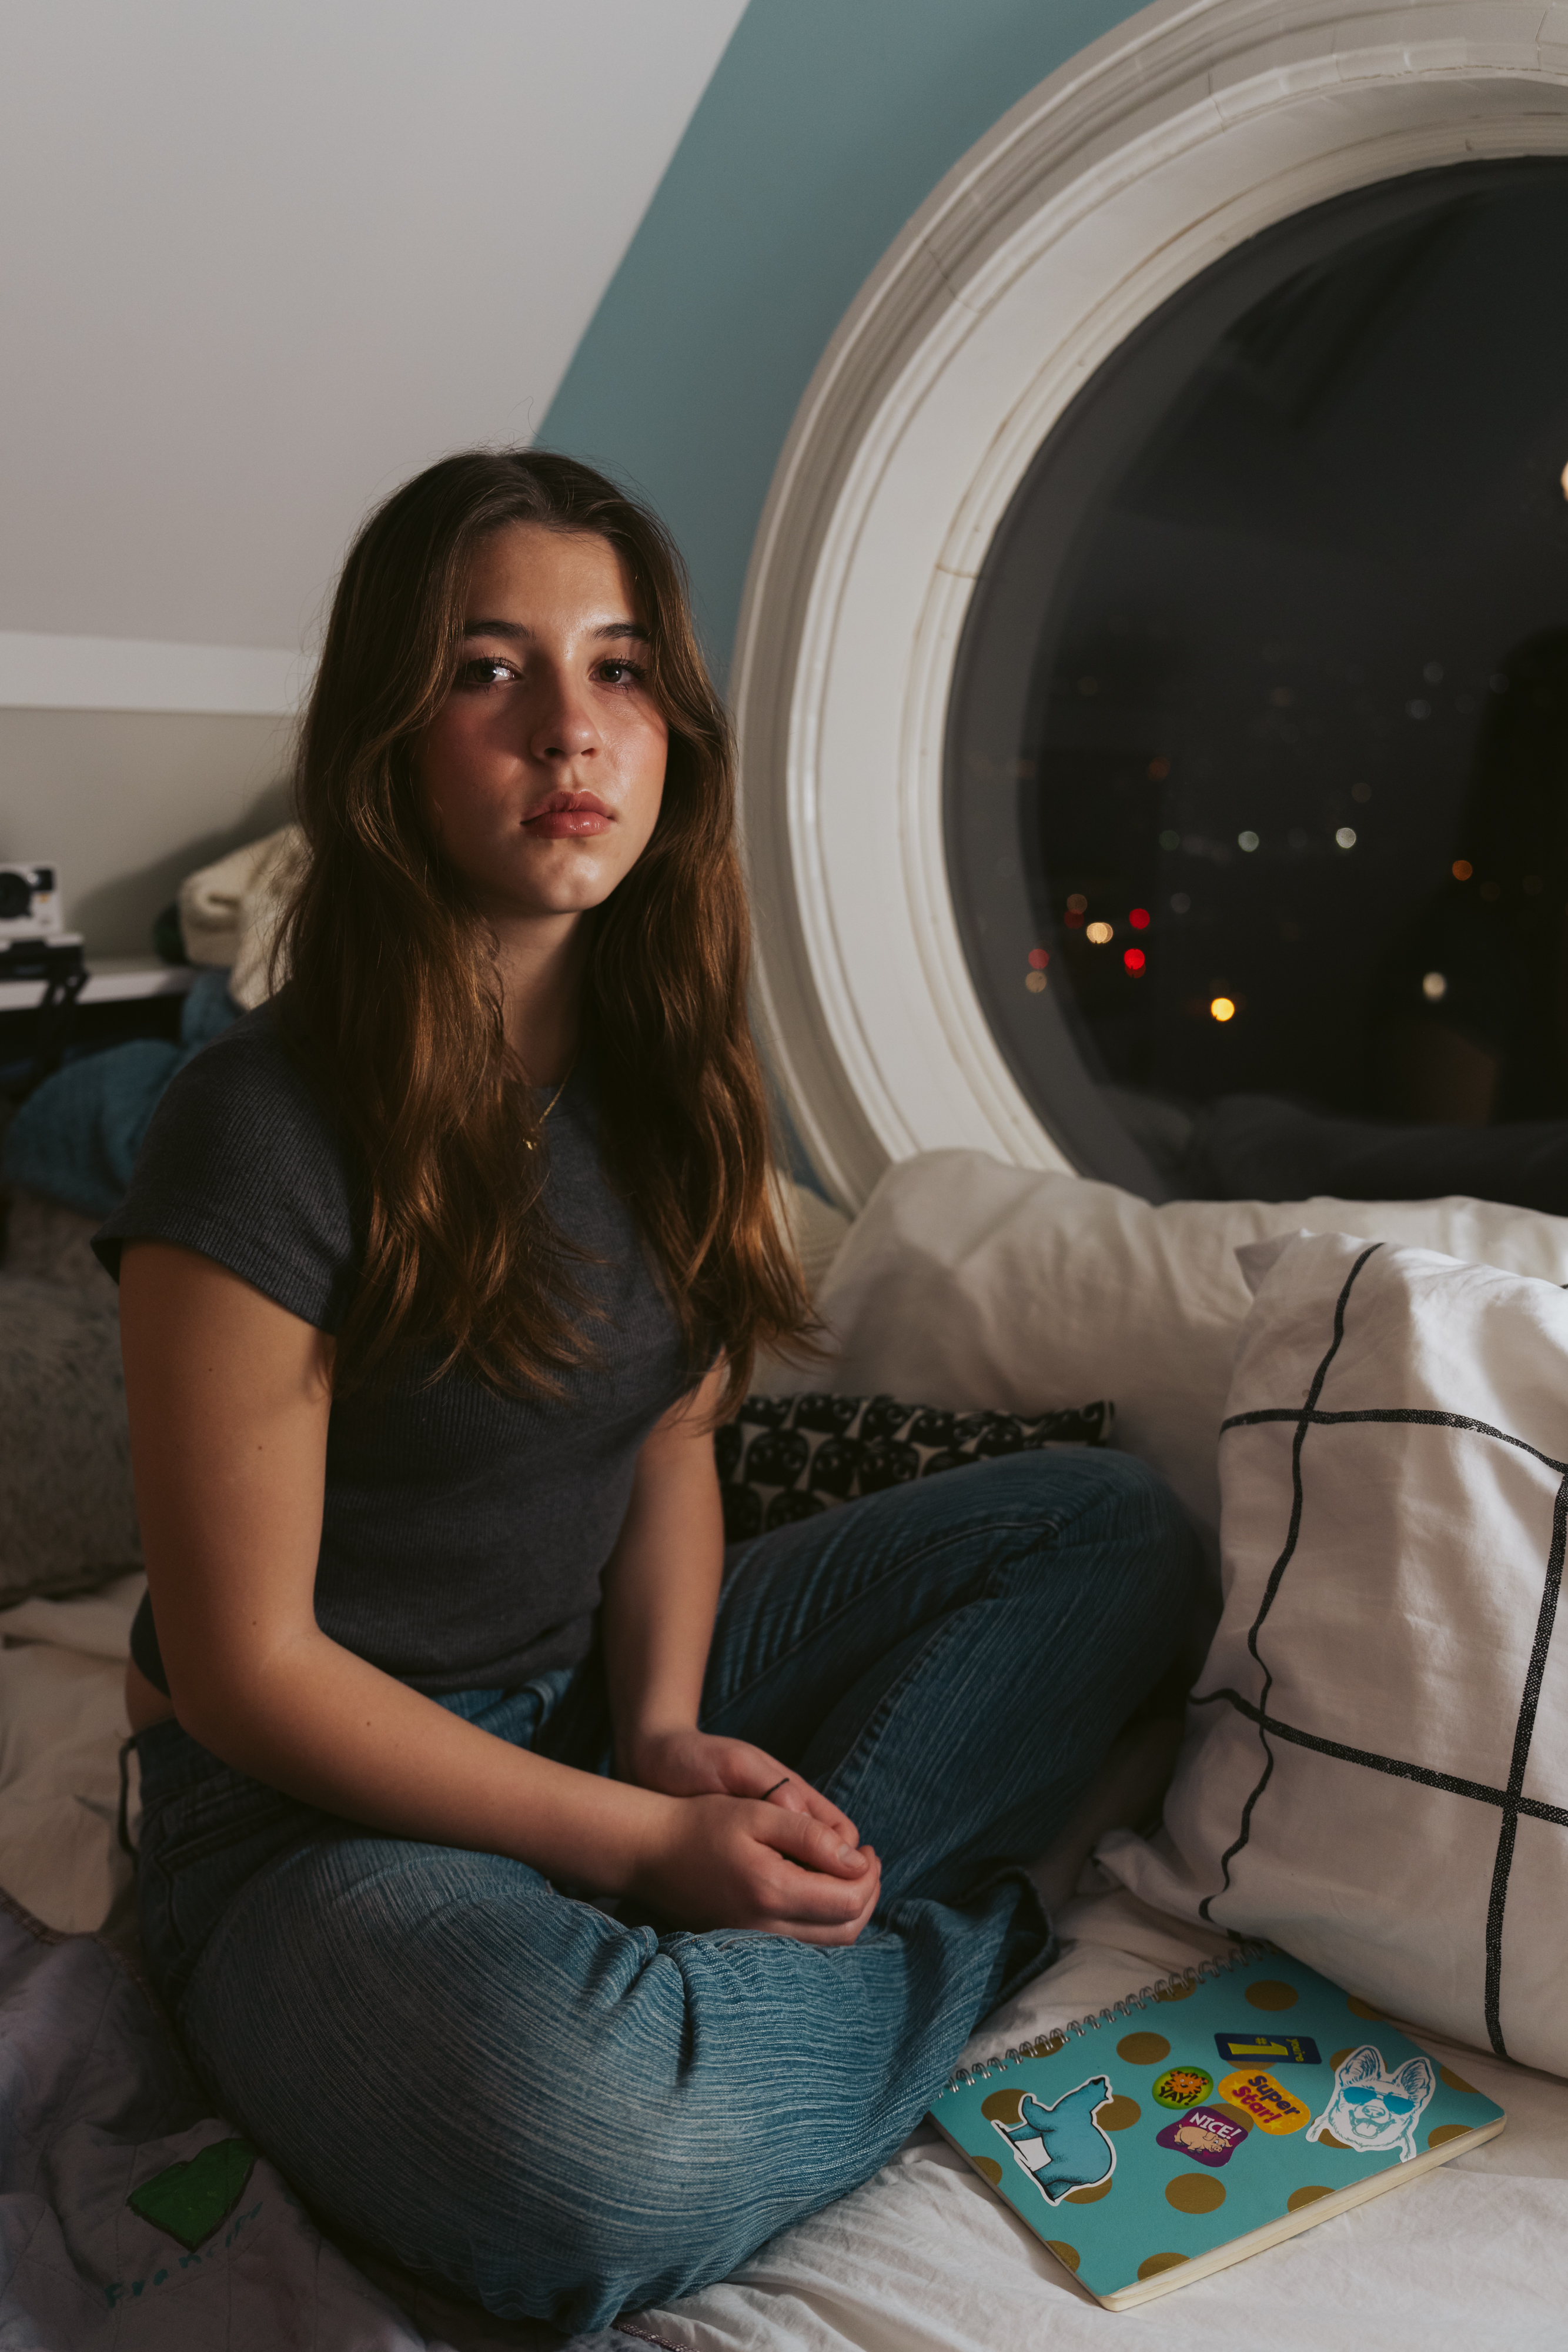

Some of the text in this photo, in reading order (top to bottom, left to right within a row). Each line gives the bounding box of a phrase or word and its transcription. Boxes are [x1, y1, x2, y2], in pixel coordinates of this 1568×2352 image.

[1158, 2086, 1198, 2106] YAY!
[1232, 2086, 1283, 2124] Star!
[1248, 2075, 1300, 2115] Super
[1189, 2112, 1242, 2140] NICE!
